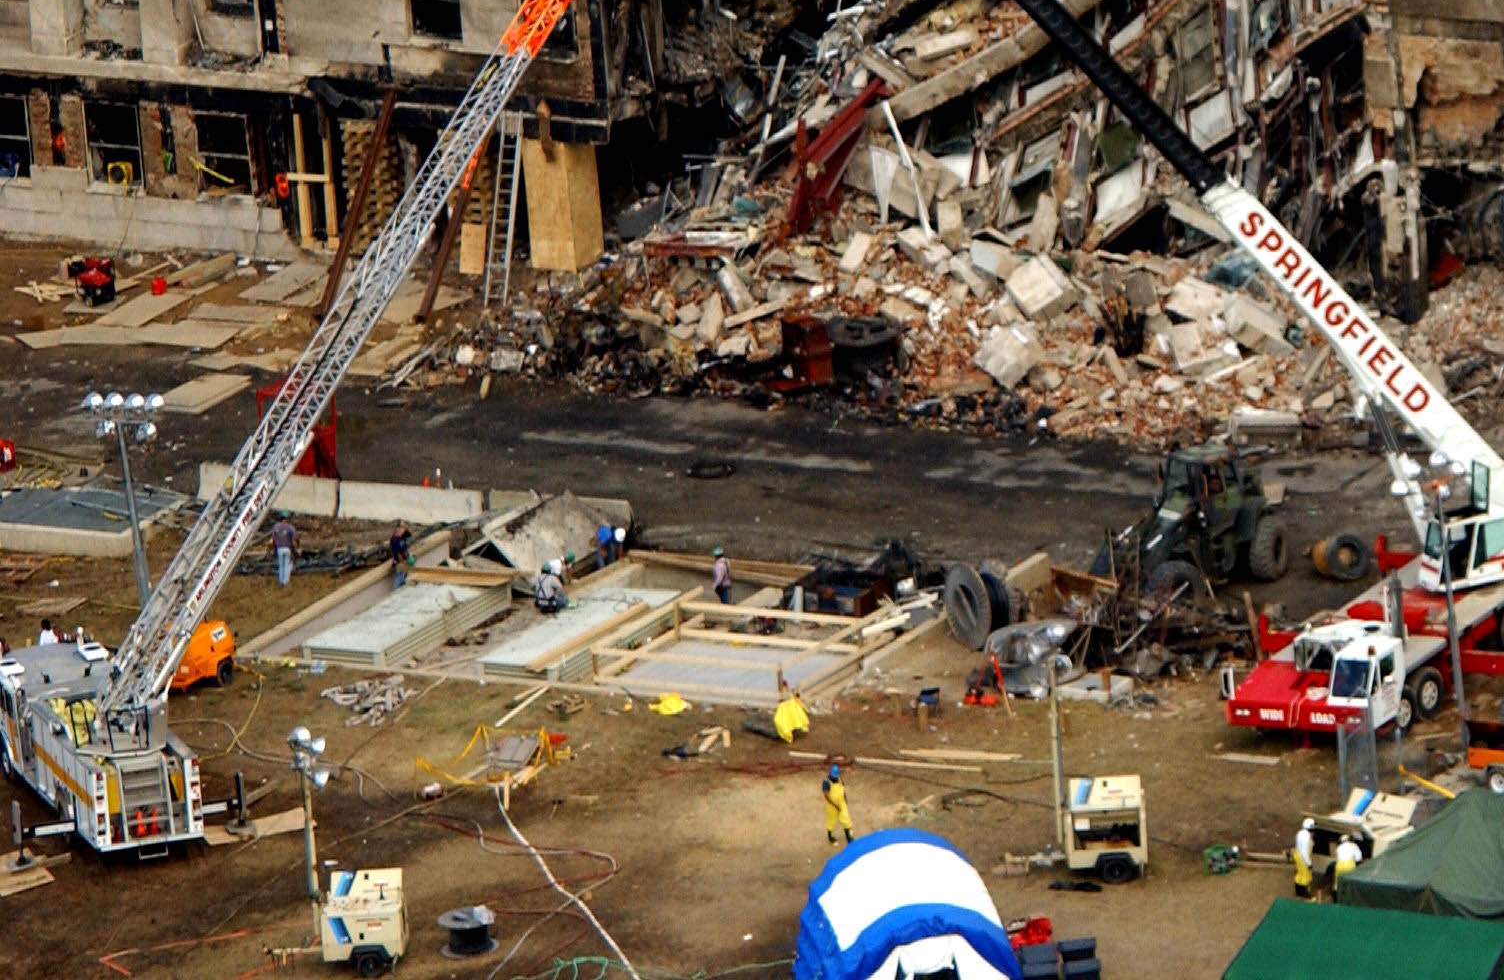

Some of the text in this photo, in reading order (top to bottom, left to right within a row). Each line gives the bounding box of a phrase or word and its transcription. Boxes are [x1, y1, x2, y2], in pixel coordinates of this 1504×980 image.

[1239, 211, 1430, 413] SPRINGFIELD
[1259, 708, 1336, 725] WIDE LOAD
